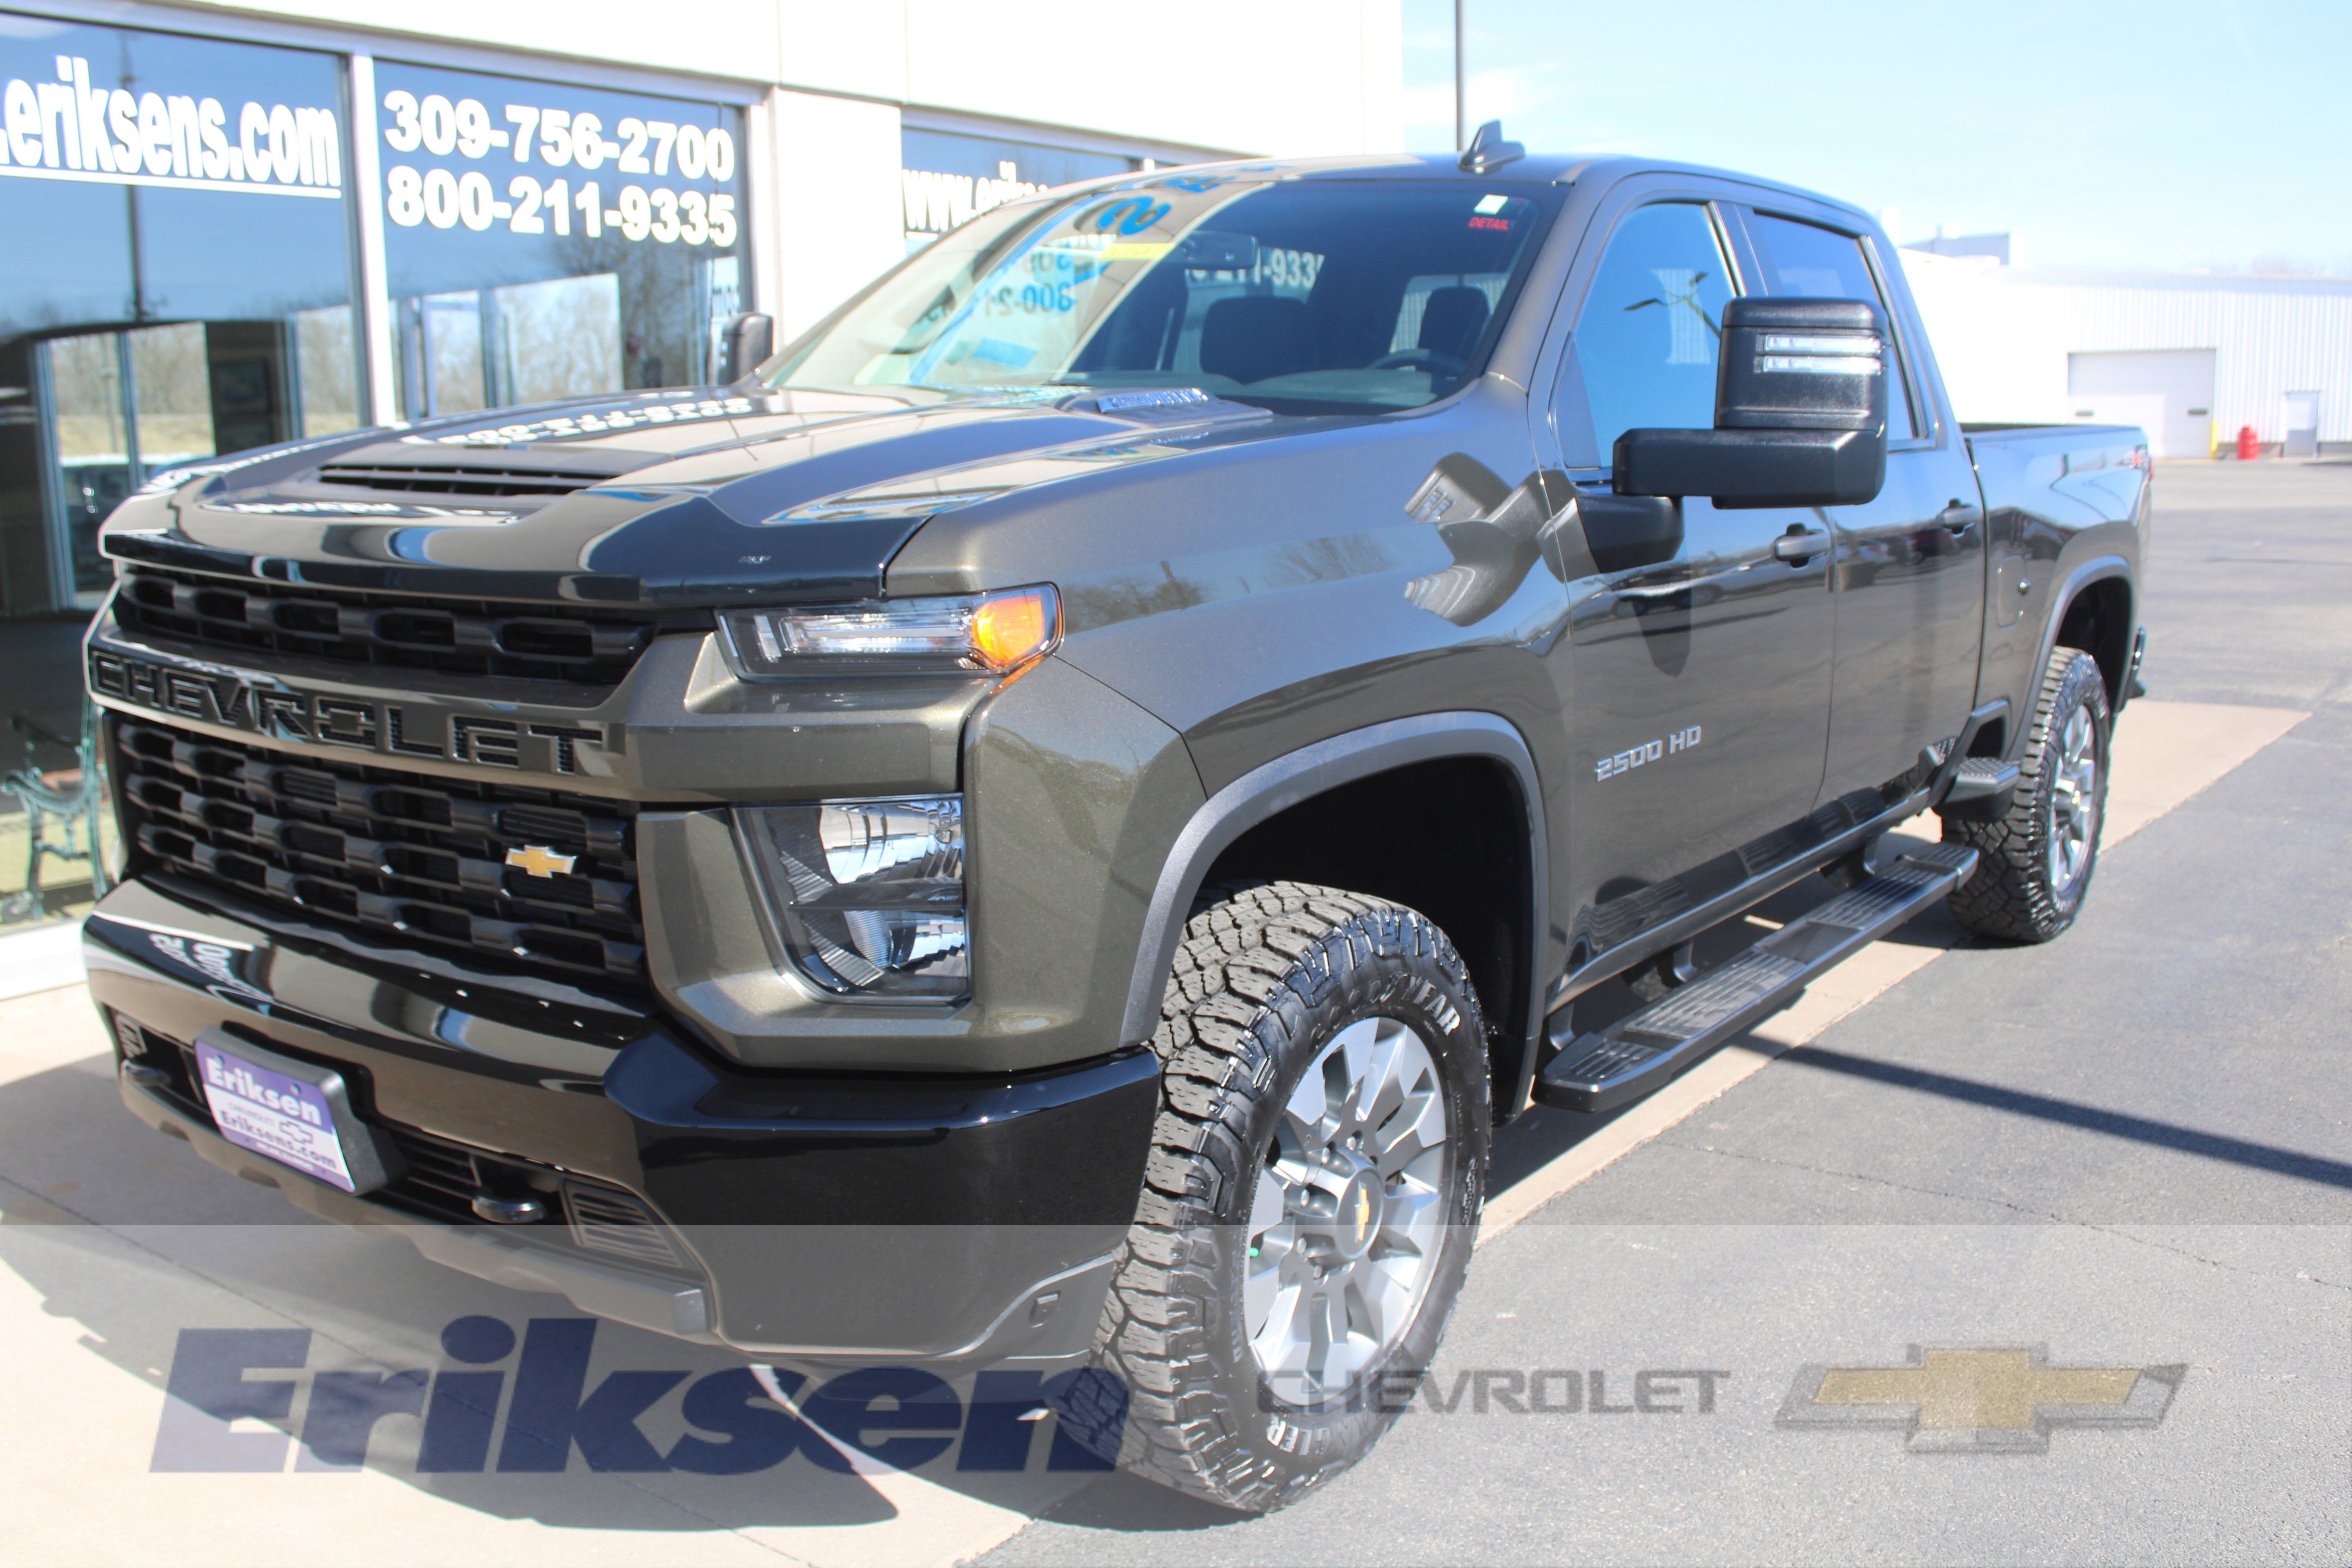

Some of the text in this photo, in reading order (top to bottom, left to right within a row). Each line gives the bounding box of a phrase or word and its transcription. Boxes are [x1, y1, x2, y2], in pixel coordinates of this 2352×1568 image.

[384, 90, 735, 182] 309-756-2700
[387, 165, 737, 247] 800-211-9335
[92, 651, 608, 774] CHEVROLET
[1595, 725, 1702, 782] 2500 HD
[205, 1057, 323, 1127] Eriksen
